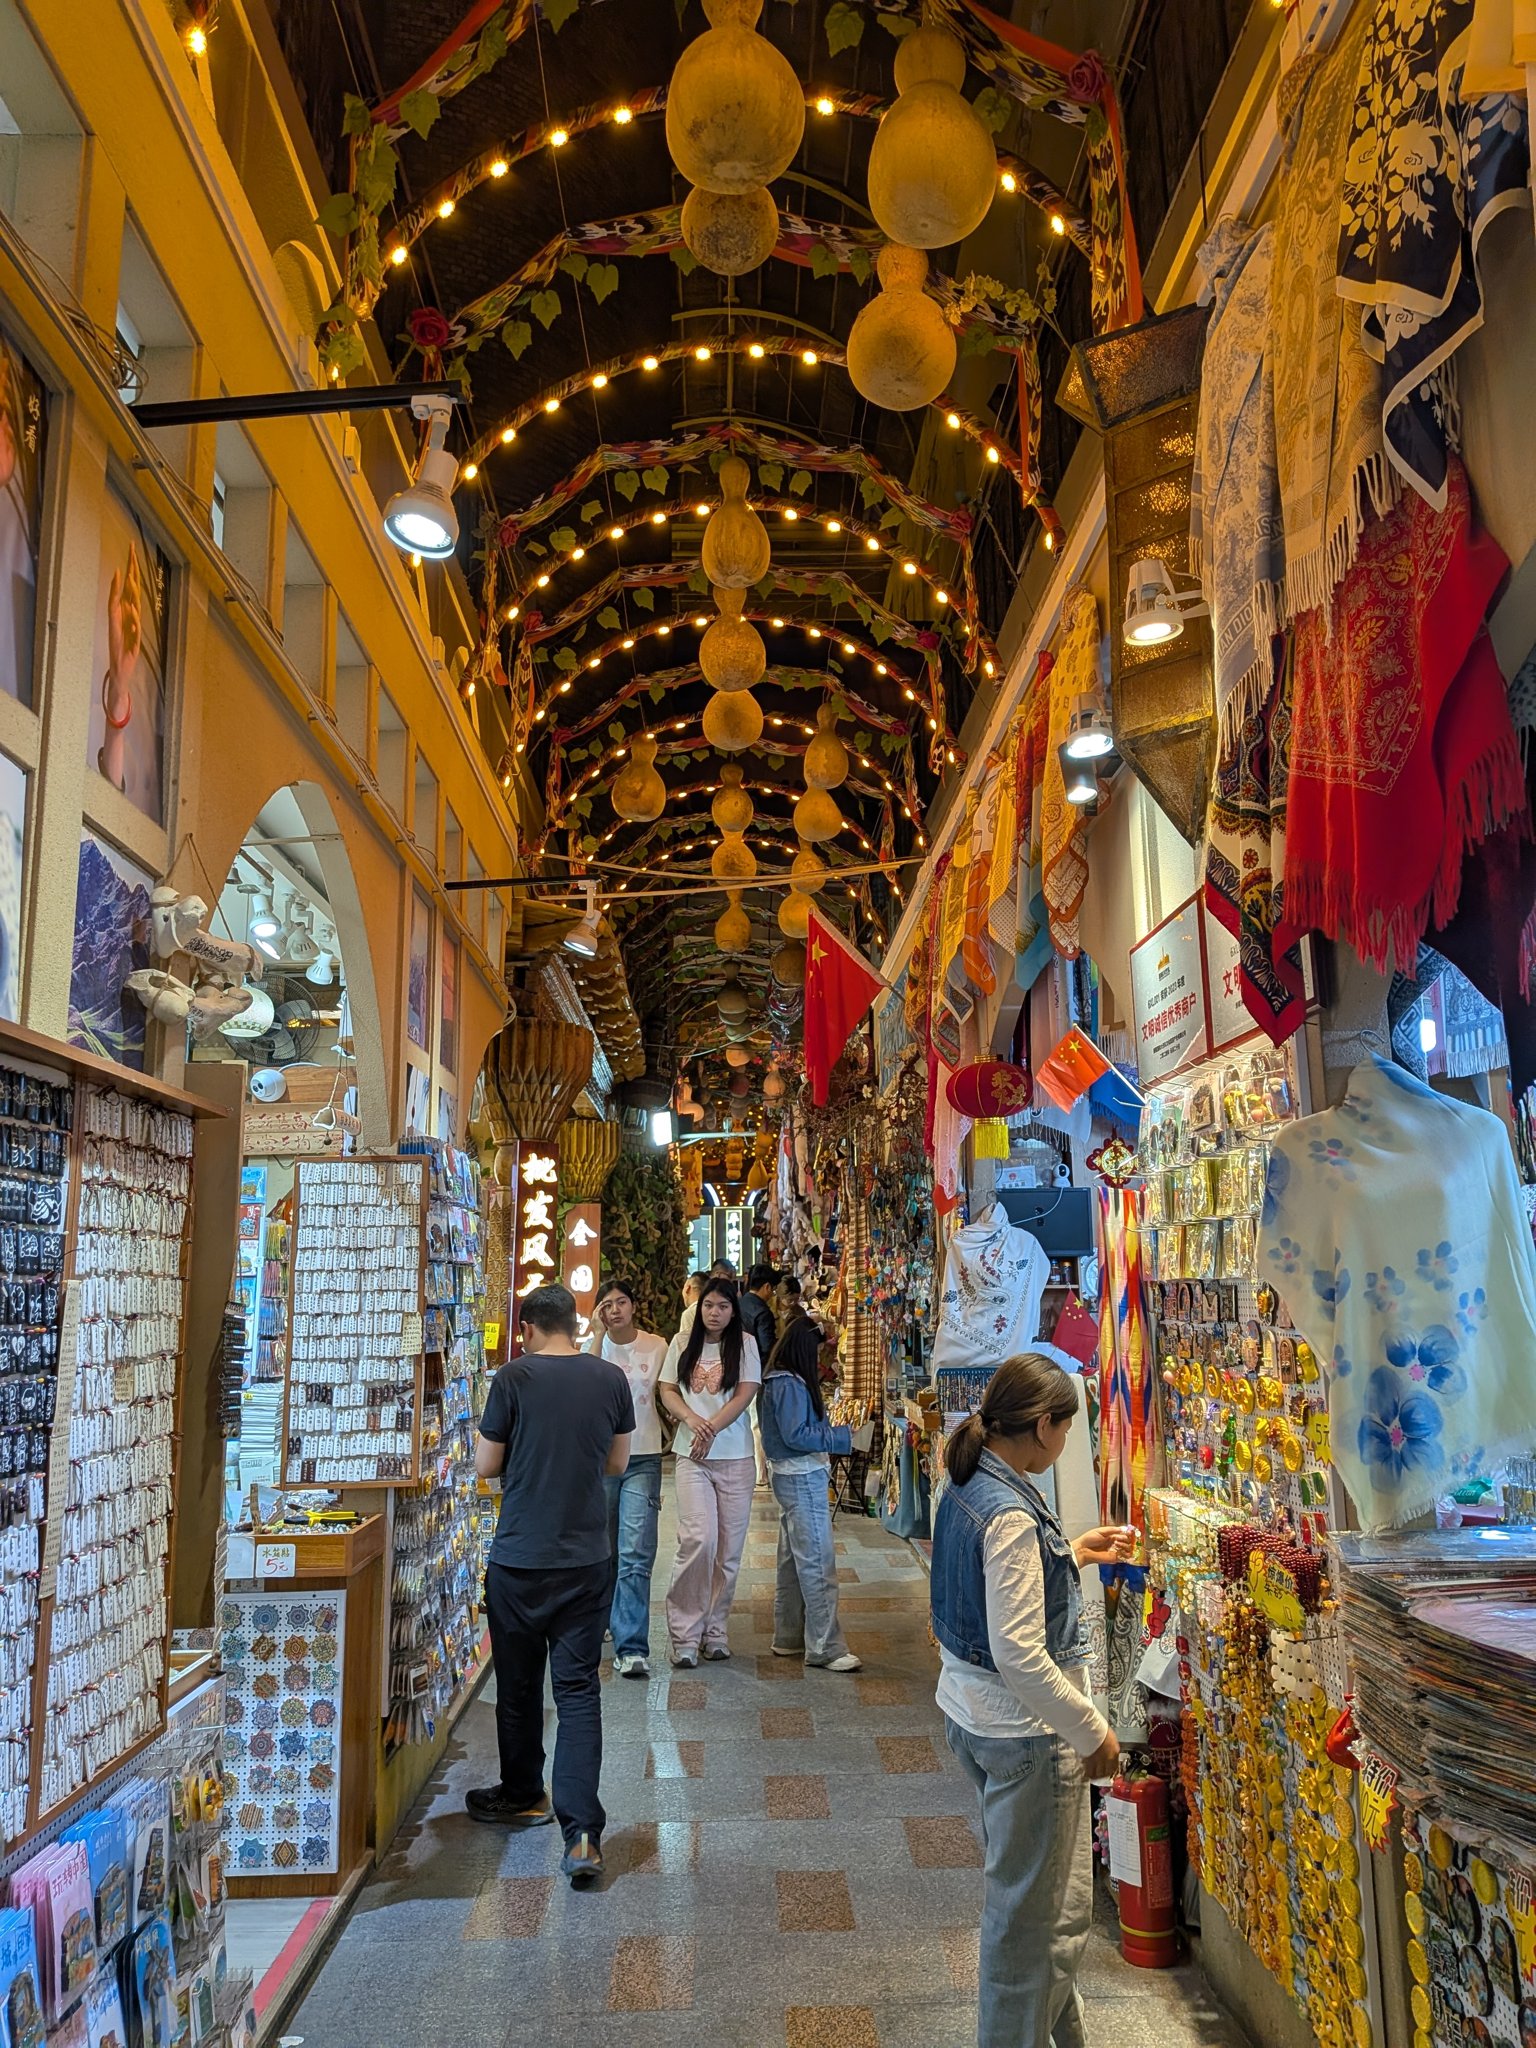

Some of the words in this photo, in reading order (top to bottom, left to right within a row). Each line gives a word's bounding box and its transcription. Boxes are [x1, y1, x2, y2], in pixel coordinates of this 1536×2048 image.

[1141, 991, 1197, 1043] 文明诚信优秀商户
[262, 1558, 289, 1575] 5元
[1267, 1565, 1293, 1591] 惊爆价
[1362, 1754, 1397, 1800] 特价
[52, 1846, 89, 1899] 玩转中国
